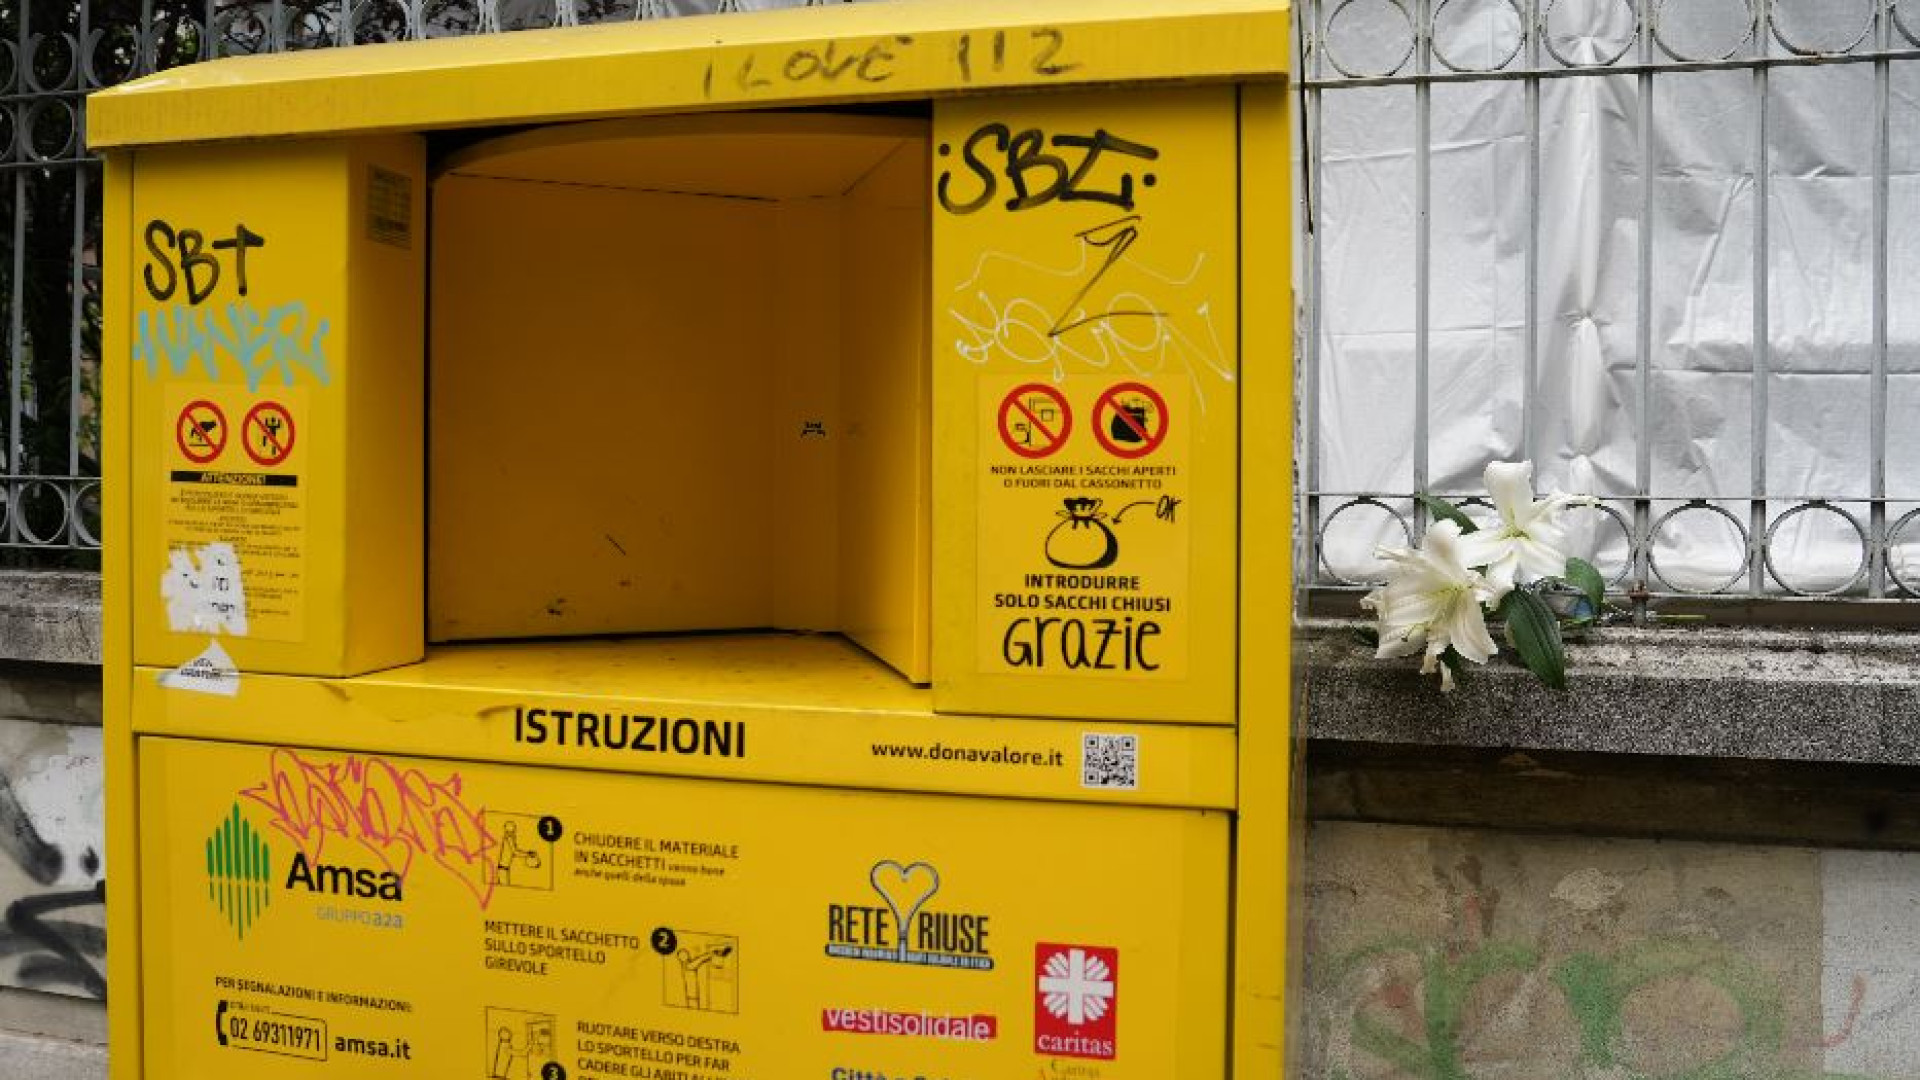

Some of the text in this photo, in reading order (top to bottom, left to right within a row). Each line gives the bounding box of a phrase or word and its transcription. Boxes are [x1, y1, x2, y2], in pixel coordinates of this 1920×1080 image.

[143, 219, 265, 305] SBT
[991, 465, 1017, 475] NON
[1020, 465, 1076, 476] LASCIARE
[1086, 466, 1131, 477] SACCHI
[1133, 466, 1177, 477] APERTI
[1015, 478, 1051, 489] FUORI
[1053, 478, 1076, 489] DAL
[1080, 479, 1162, 490] CASSONETTO
[1024, 573, 1140, 591] INTRODURRE
[994, 593, 1171, 613] SOLO SACCHI CHIUSI
[513, 706, 746, 759] ISTRUZIONI
[870, 741, 1064, 769] www.donavalore.it
[573, 830, 642, 850] CHIUDERE
[659, 839, 740, 859] MATERIALE
[573, 849, 589, 863] IN
[591, 851, 666, 871] SACCHETTI
[285, 851, 403, 902] Amsa
[484, 919, 641, 949] METTERE IL SACCHETTO
[828, 903, 990, 955] RETE RIUSE
[484, 937, 606, 965] SULLO SPORTELLO
[484, 956, 549, 976] GIREVOLE
[215, 976, 236, 989] PER
[229, 1016, 321, 1052] 02 69311971
[576, 1020, 741, 1054] RUOTARE VERSO DESTRA
[826, 1007, 991, 1042] vestisolidale
[334, 1035, 412, 1060] amsa.it
[576, 1038, 730, 1072] LO SPORTELLO PER FAR
[577, 1056, 629, 1076] CADERE
